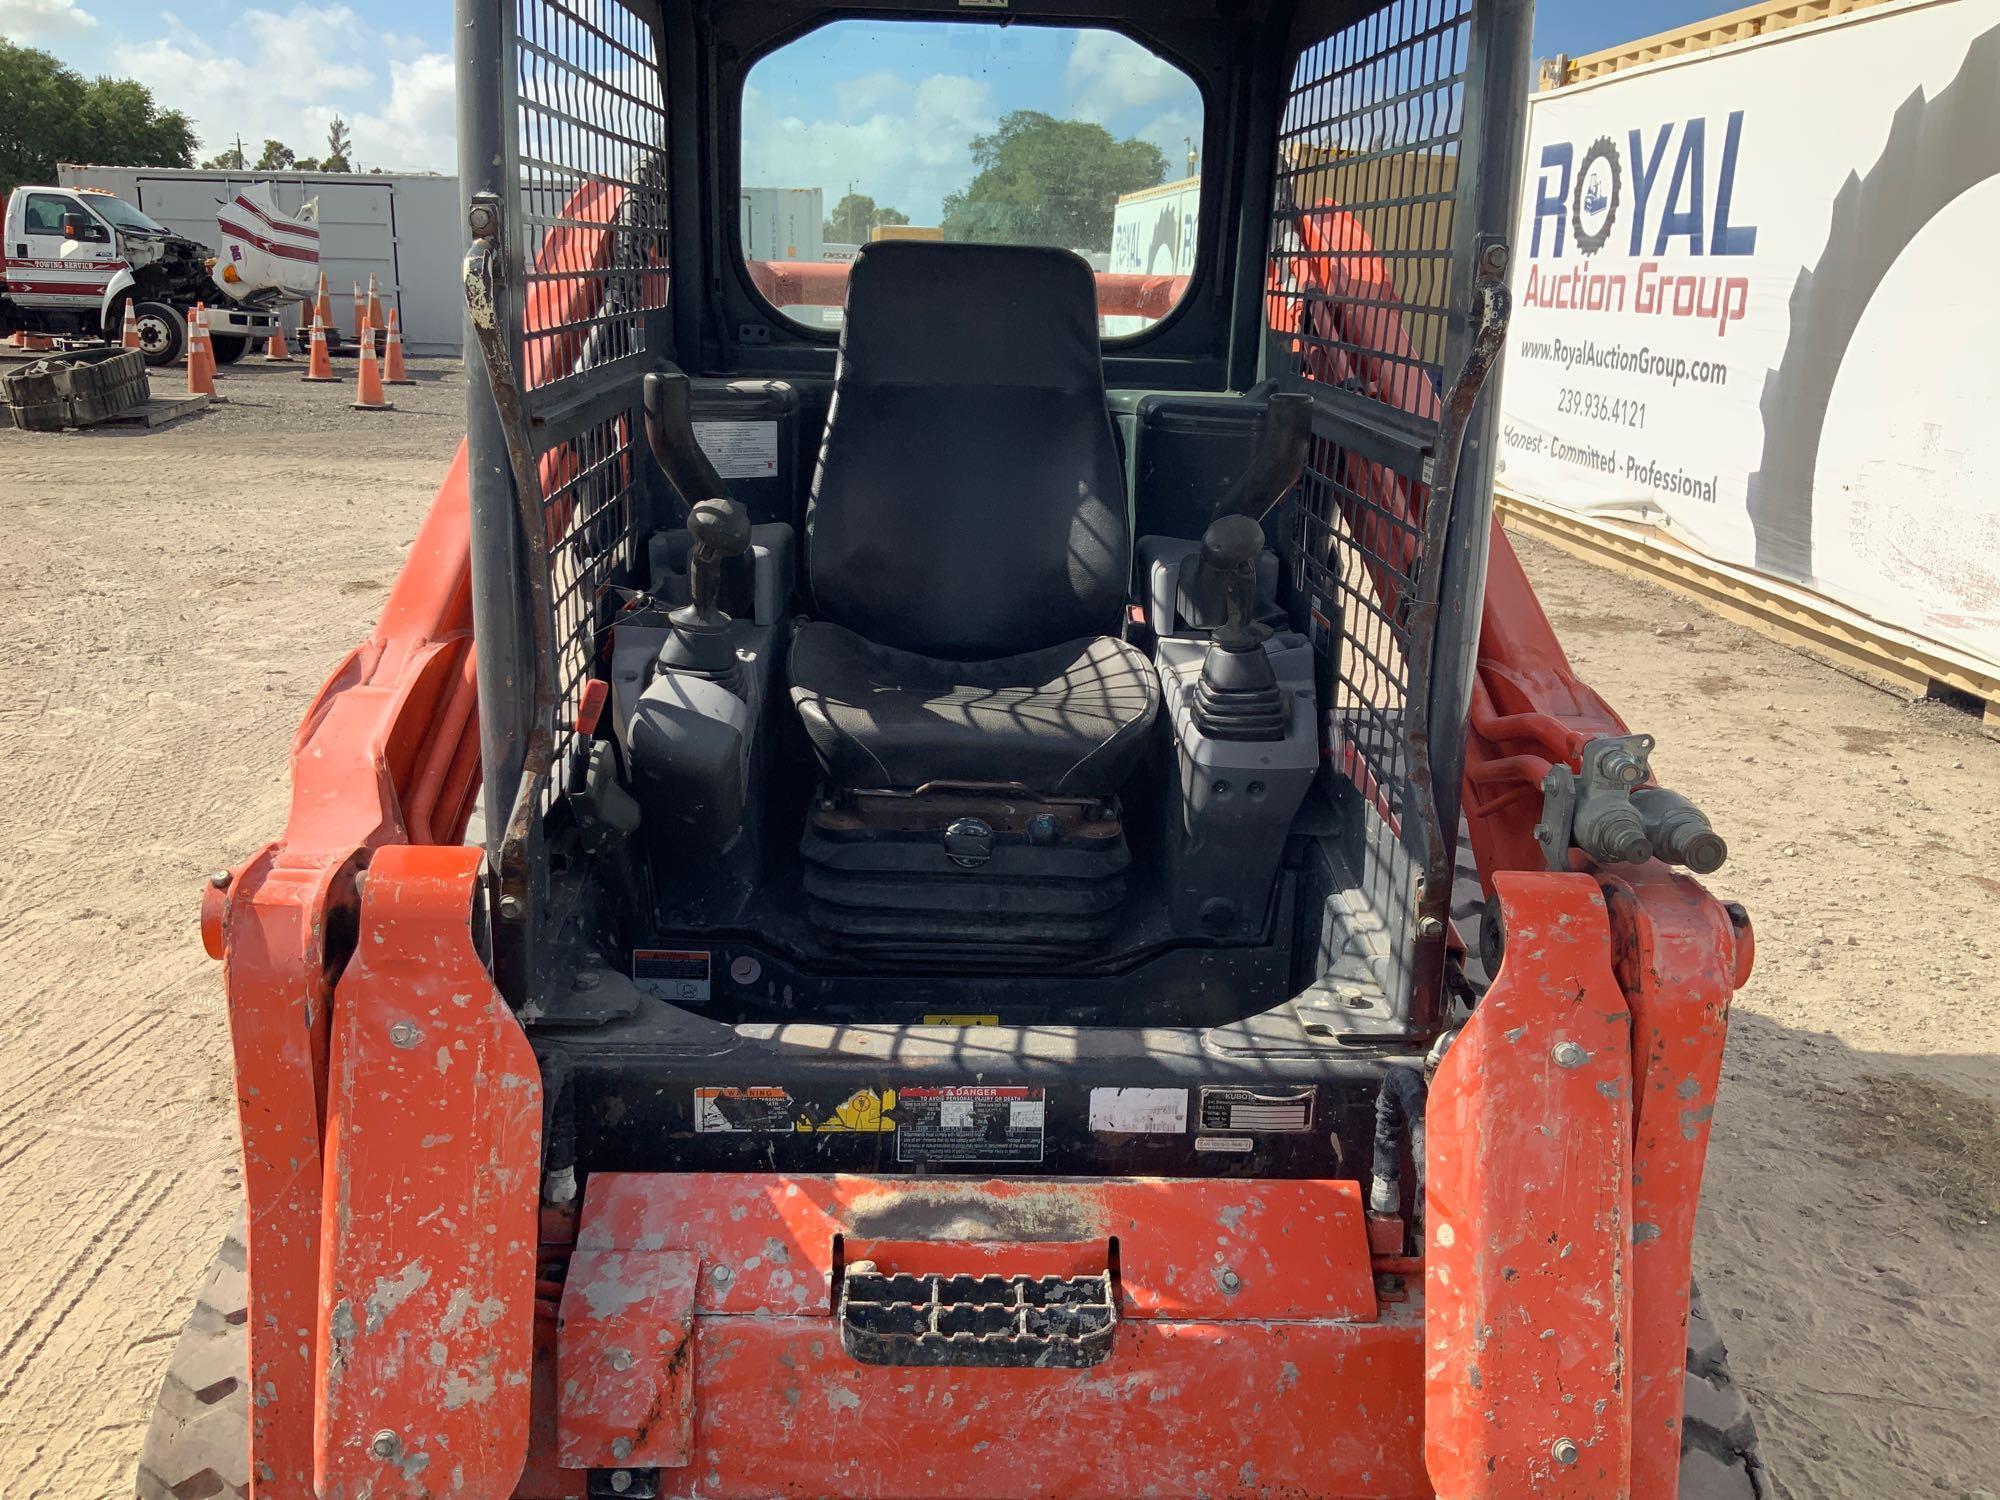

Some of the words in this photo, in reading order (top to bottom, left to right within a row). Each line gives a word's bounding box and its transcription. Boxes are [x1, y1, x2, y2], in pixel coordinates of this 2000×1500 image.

[1530, 110, 1758, 258] ROYAL
[34, 261, 62, 269] TOWING
[64, 262, 93, 270] SERVICE
[1524, 261, 1626, 313] Auction
[1634, 262, 1749, 337] Group
[1521, 338, 1728, 386] www.RoyalAuctionGroup.com
[1557, 388, 1646, 429] 239.936.4121
[1504, 424, 1543, 454] Honest
[1550, 436, 1616, 474] Committed
[1626, 455, 1718, 504] Professional
[956, 1088, 997, 1096] DANGER
